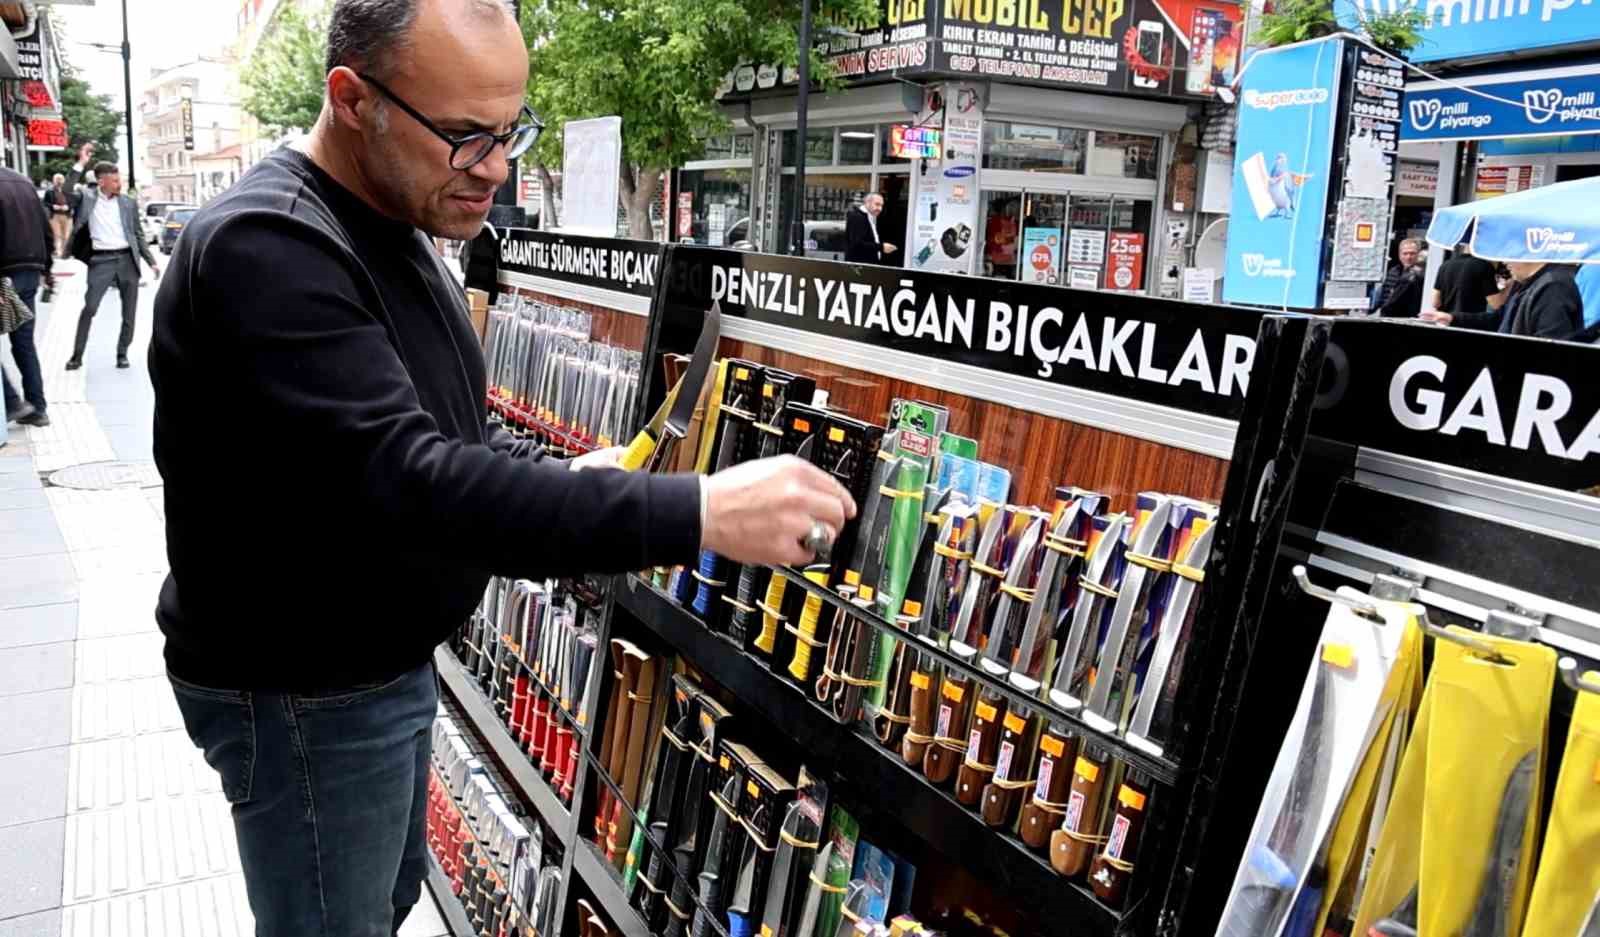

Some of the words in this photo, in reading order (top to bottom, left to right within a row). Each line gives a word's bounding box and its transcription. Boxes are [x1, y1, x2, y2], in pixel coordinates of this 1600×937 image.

[942, 42, 972, 55] TABLET
[974, 43, 1004, 58] TAMİRİ
[1023, 52, 1033, 62] EL
[1034, 53, 1069, 66] TELEFON
[1070, 56, 1089, 68] ALIM
[943, 25, 975, 42] KIRIK
[977, 30, 1015, 47] EKRAN
[1017, 32, 1056, 51] TAMİRİ
[1058, 39, 1066, 53] &
[1069, 37, 1118, 59] DEĞİŞİMİ
[868, 41, 927, 72] SERVİS
[950, 55, 976, 71] CEP
[978, 56, 1041, 79] TELEFONU
[1441, 102, 1469, 116] milli
[1562, 91, 1596, 106] milli
[1439, 113, 1492, 130] piyango
[550, 239, 608, 279] SÜRMENE
[814, 277, 976, 349] YATAĞAN
